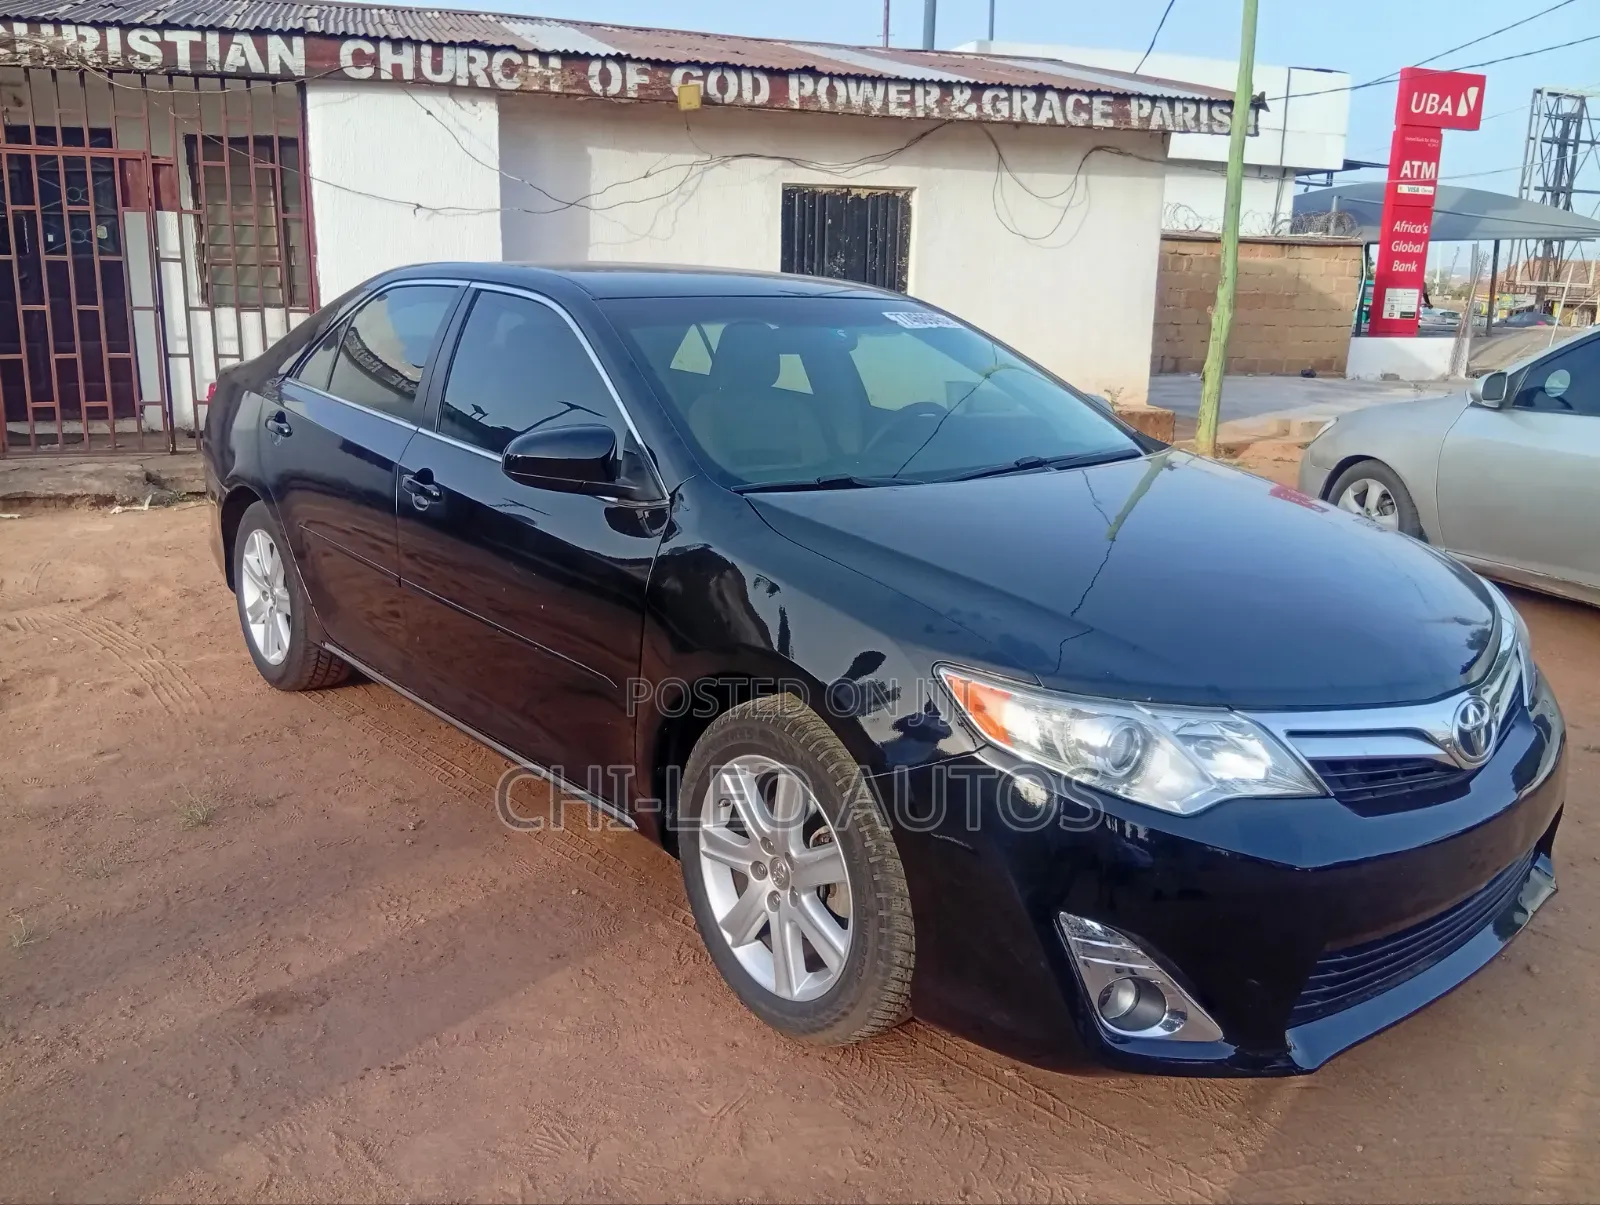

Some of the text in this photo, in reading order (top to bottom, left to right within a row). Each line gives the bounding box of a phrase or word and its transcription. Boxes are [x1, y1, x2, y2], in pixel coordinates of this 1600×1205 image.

[0, 22, 306, 77] HRISTIAN
[339, 39, 562, 92] CHURCH
[588, 58, 651, 98] OF
[671, 65, 770, 105] GOD
[1411, 91, 1453, 116] UBA
[1400, 160, 1436, 179] ATM
[1393, 220, 1429, 234] Africa's
[1391, 240, 1425, 253] Global
[1392, 260, 1418, 272] Bank
